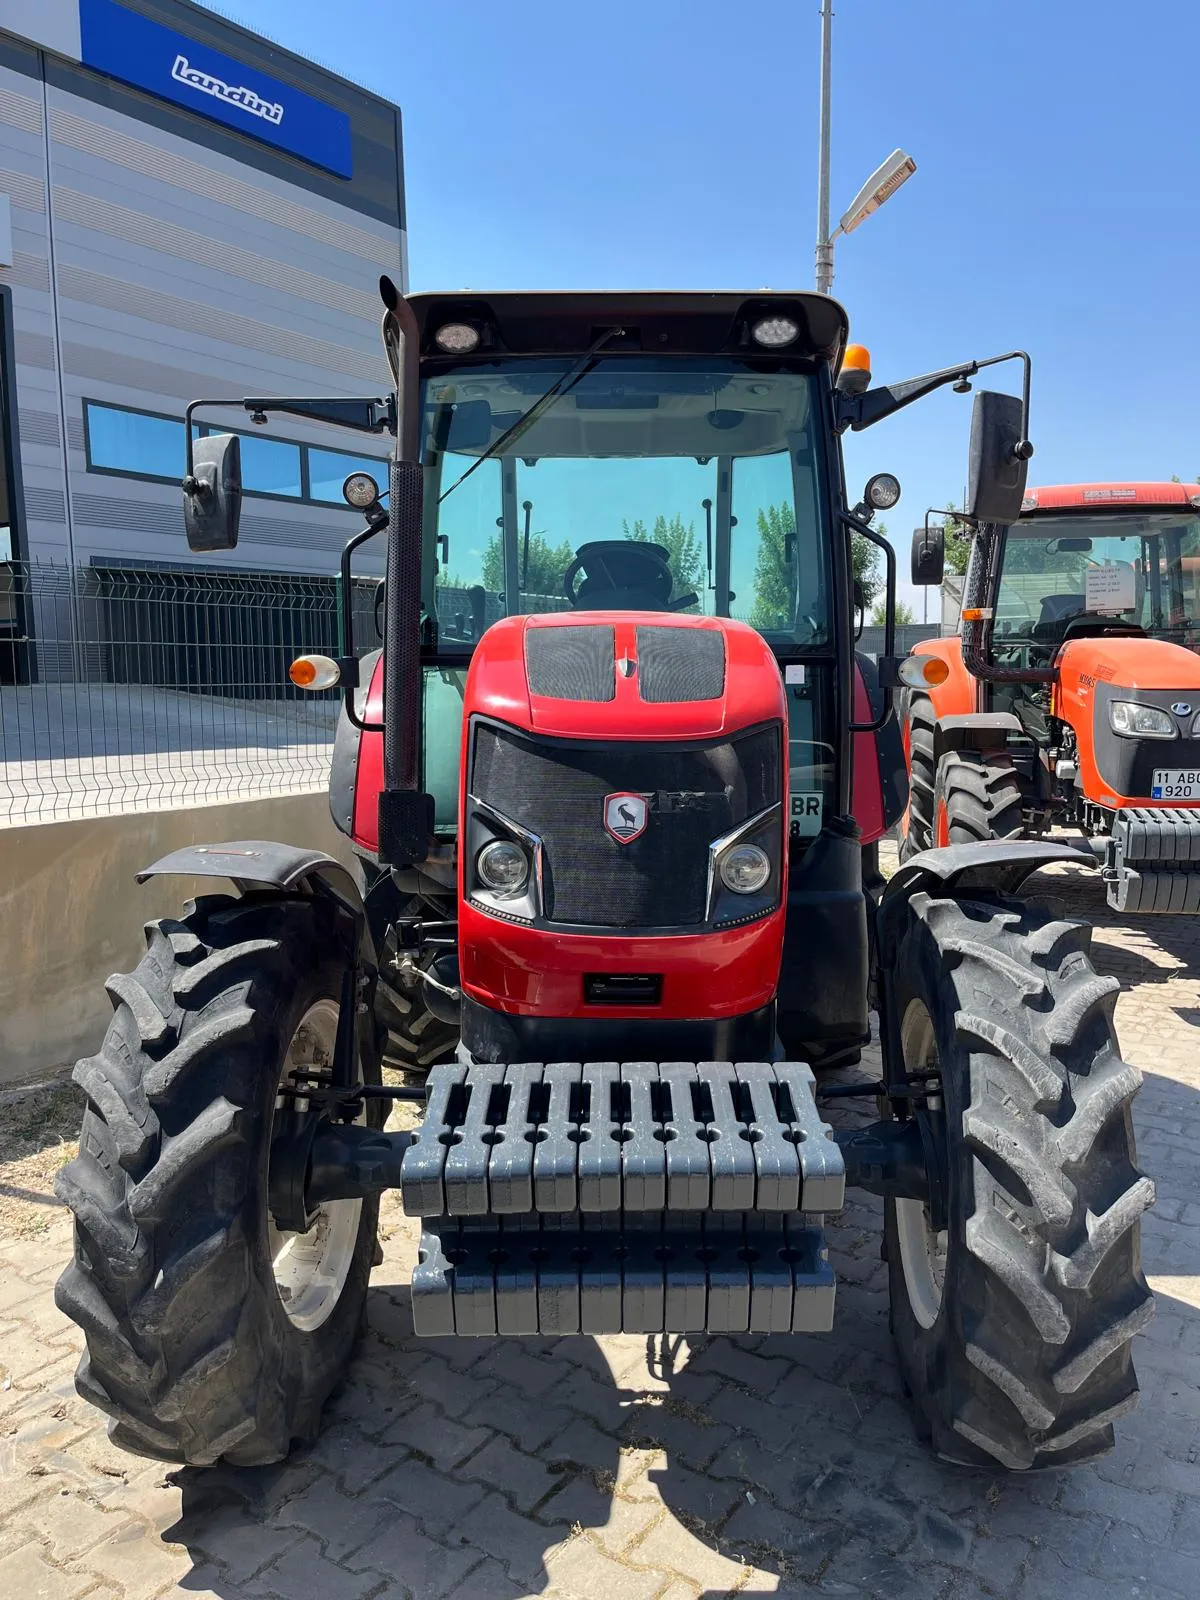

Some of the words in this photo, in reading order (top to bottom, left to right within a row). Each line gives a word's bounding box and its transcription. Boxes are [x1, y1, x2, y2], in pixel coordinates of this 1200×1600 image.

[171, 54, 284, 125] Landini
[1157, 773, 1169, 783] 11
[1165, 785, 1192, 797] 920
[791, 796, 820, 816] BR
